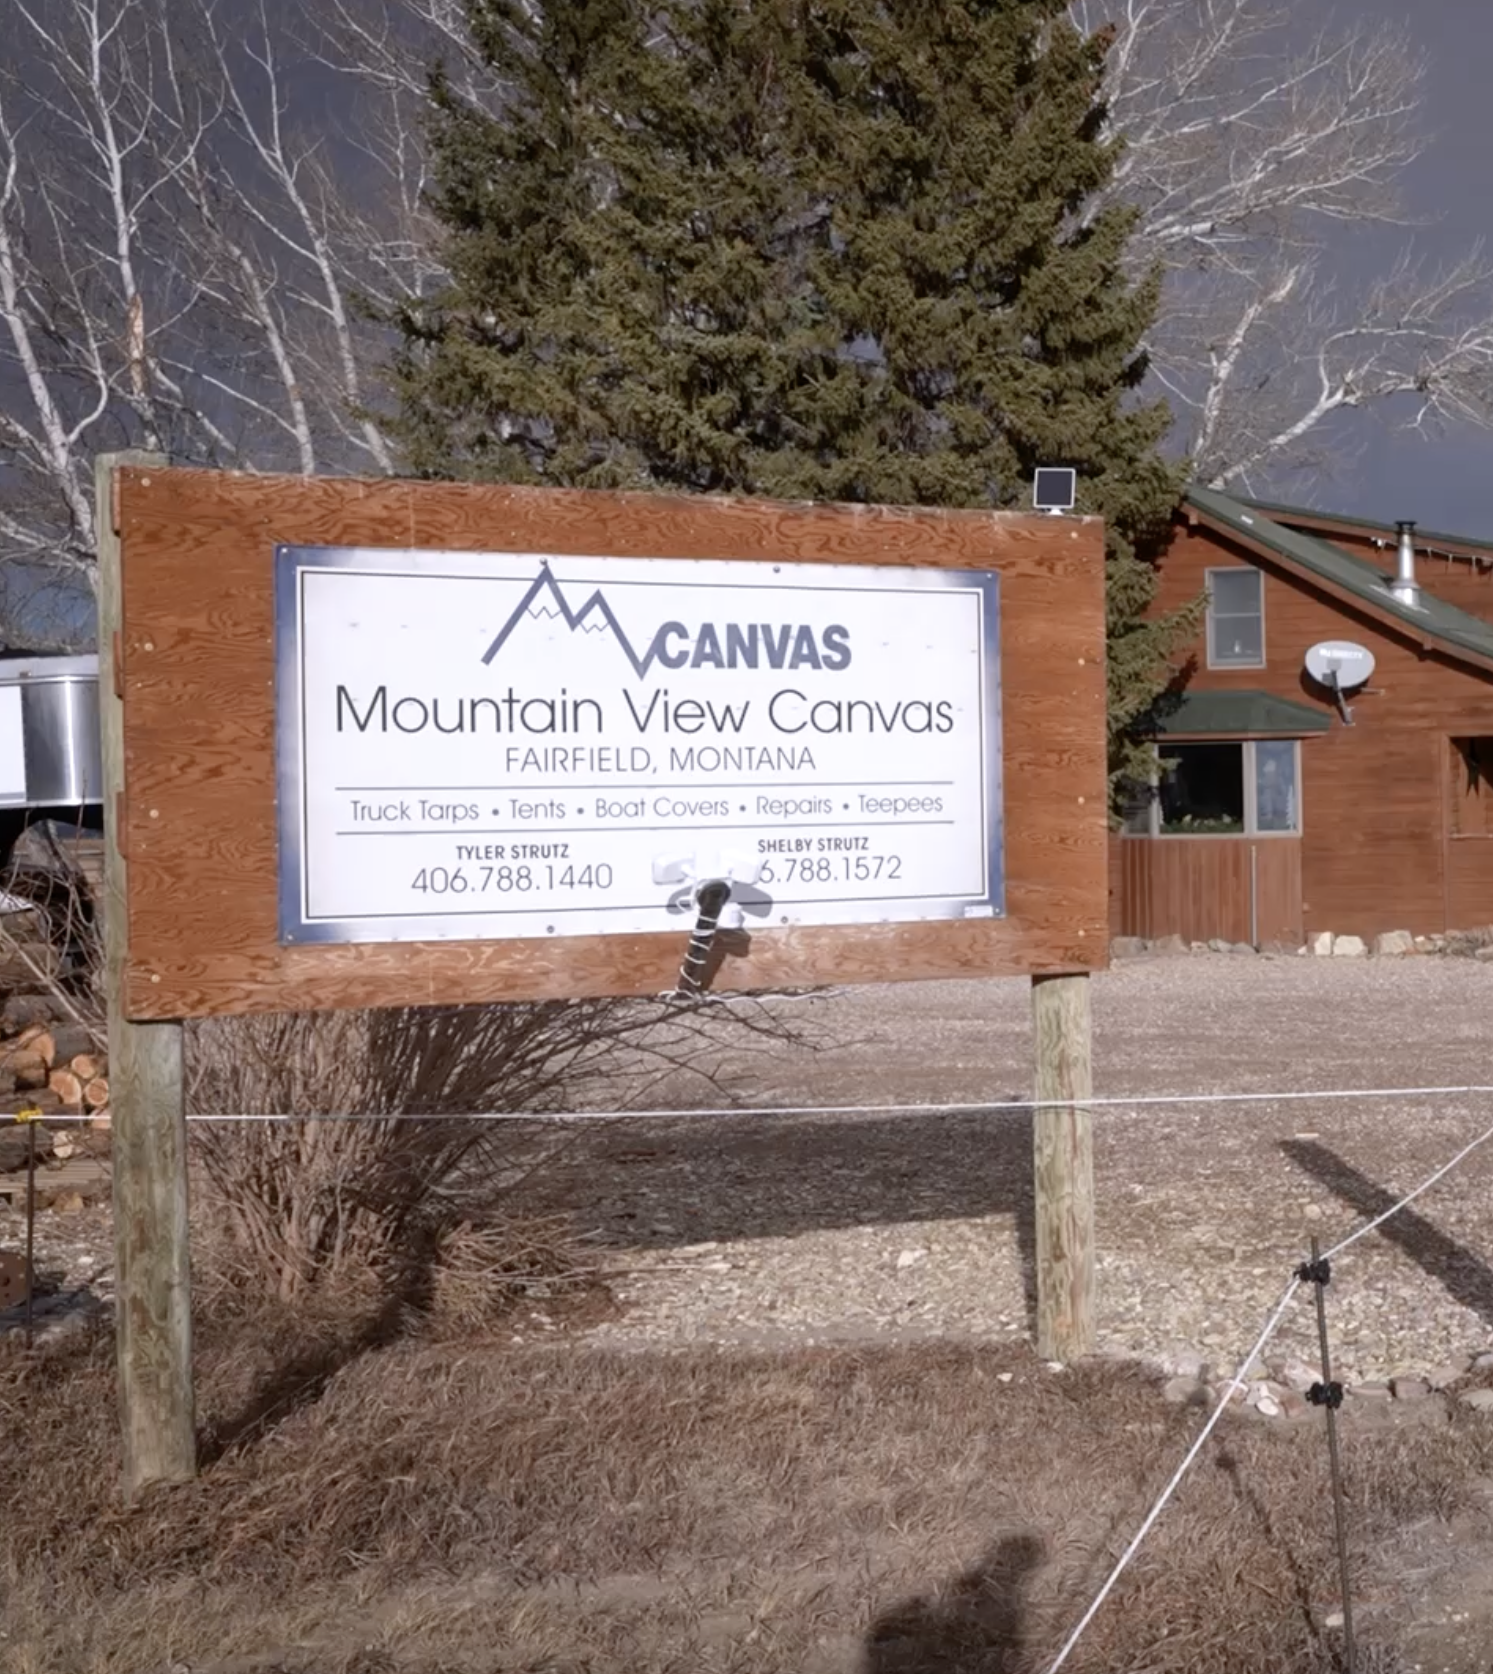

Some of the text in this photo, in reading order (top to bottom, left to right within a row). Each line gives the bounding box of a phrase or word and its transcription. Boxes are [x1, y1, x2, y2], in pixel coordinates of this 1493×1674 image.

[655, 621, 853, 672] CANVAS
[335, 684, 955, 735] Mountain View Canvas
[506, 745, 817, 776] FAIRFIELD, MONTANA
[350, 793, 944, 826] Truck Tarps Tents Boat Covers Repairs Teepees
[455, 842, 570, 861] TYLER STRUTZ
[757, 836, 870, 854] SHELBY STRUTZ
[411, 863, 614, 894] 406.788.1440
[757, 855, 903, 885] 6.788.1572
